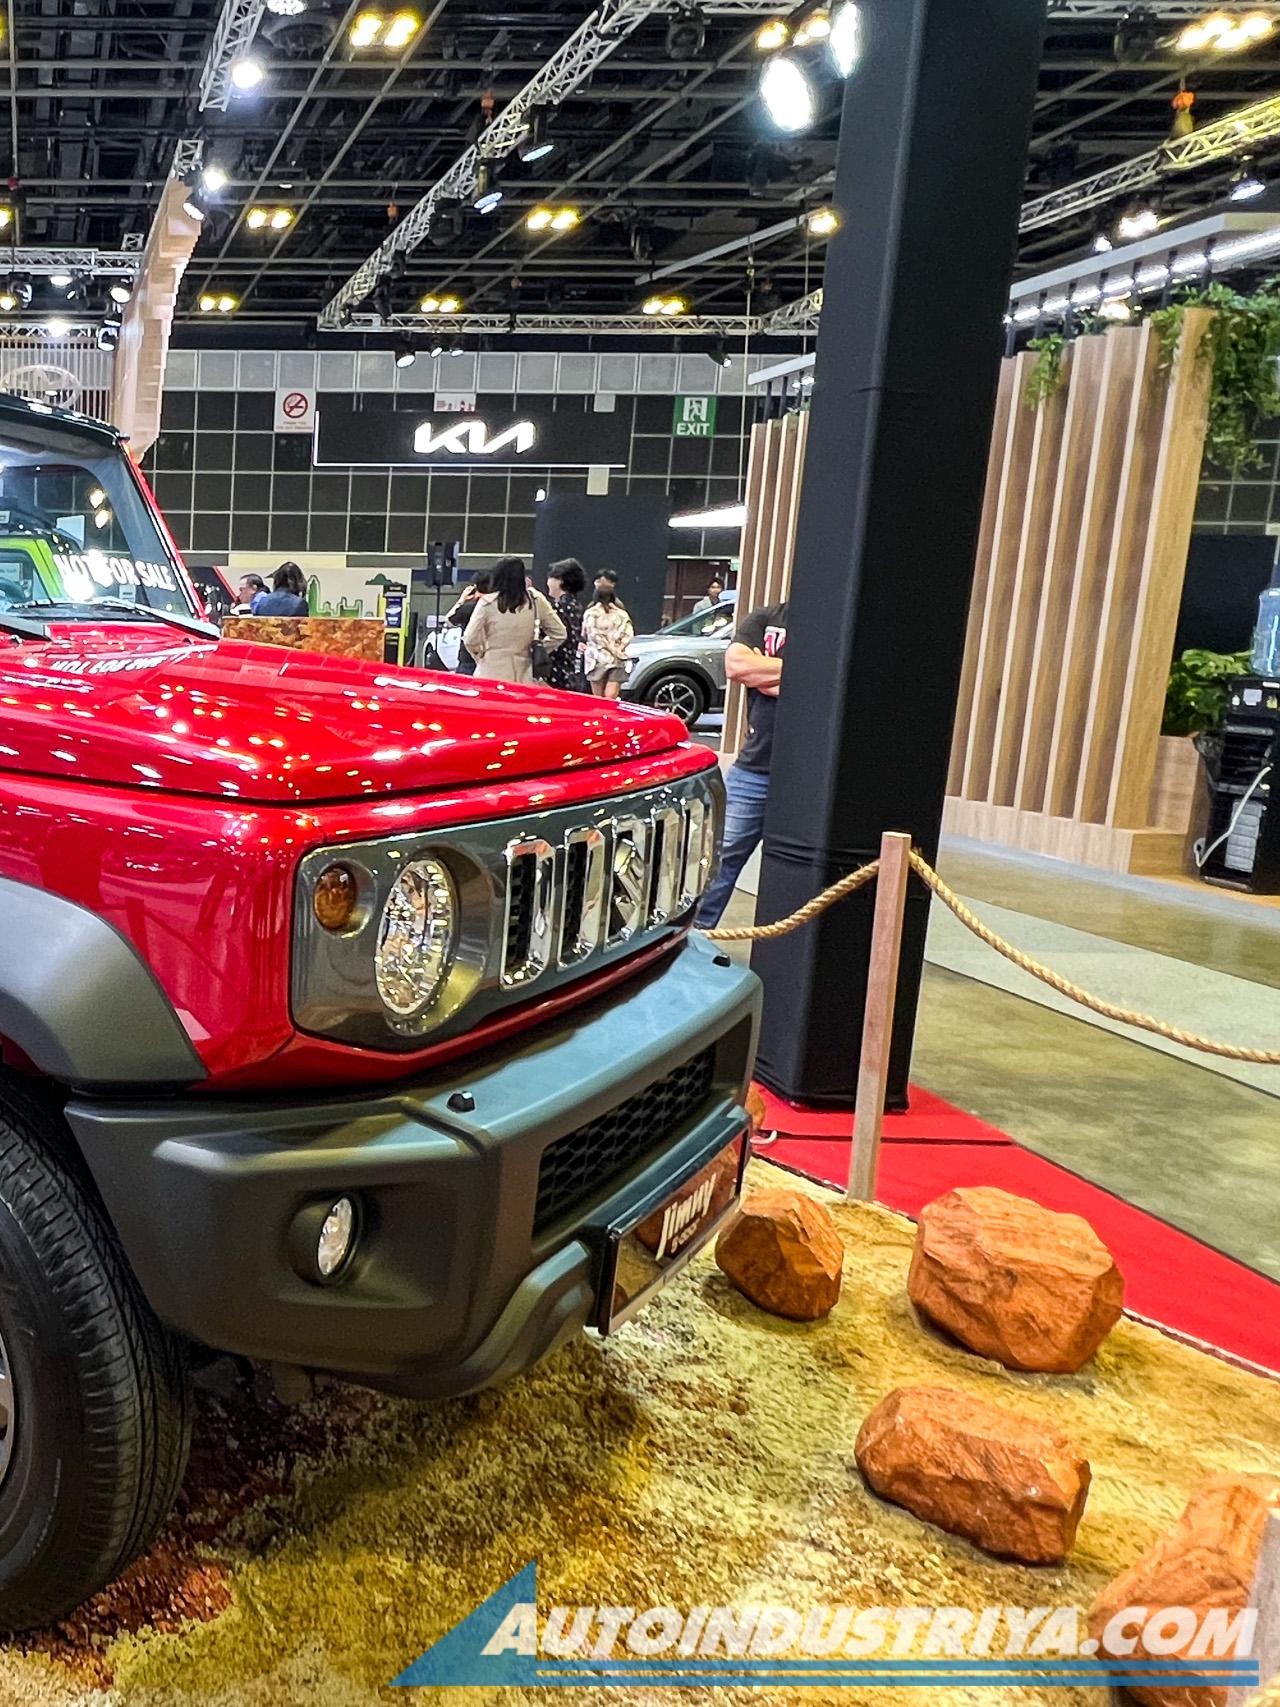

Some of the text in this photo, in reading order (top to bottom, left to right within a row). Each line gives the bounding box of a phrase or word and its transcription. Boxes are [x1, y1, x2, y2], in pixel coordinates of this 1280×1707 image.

[413, 421, 536, 454] KIA
[677, 423, 710, 436] EXIT
[134, 561, 177, 592] SALE
